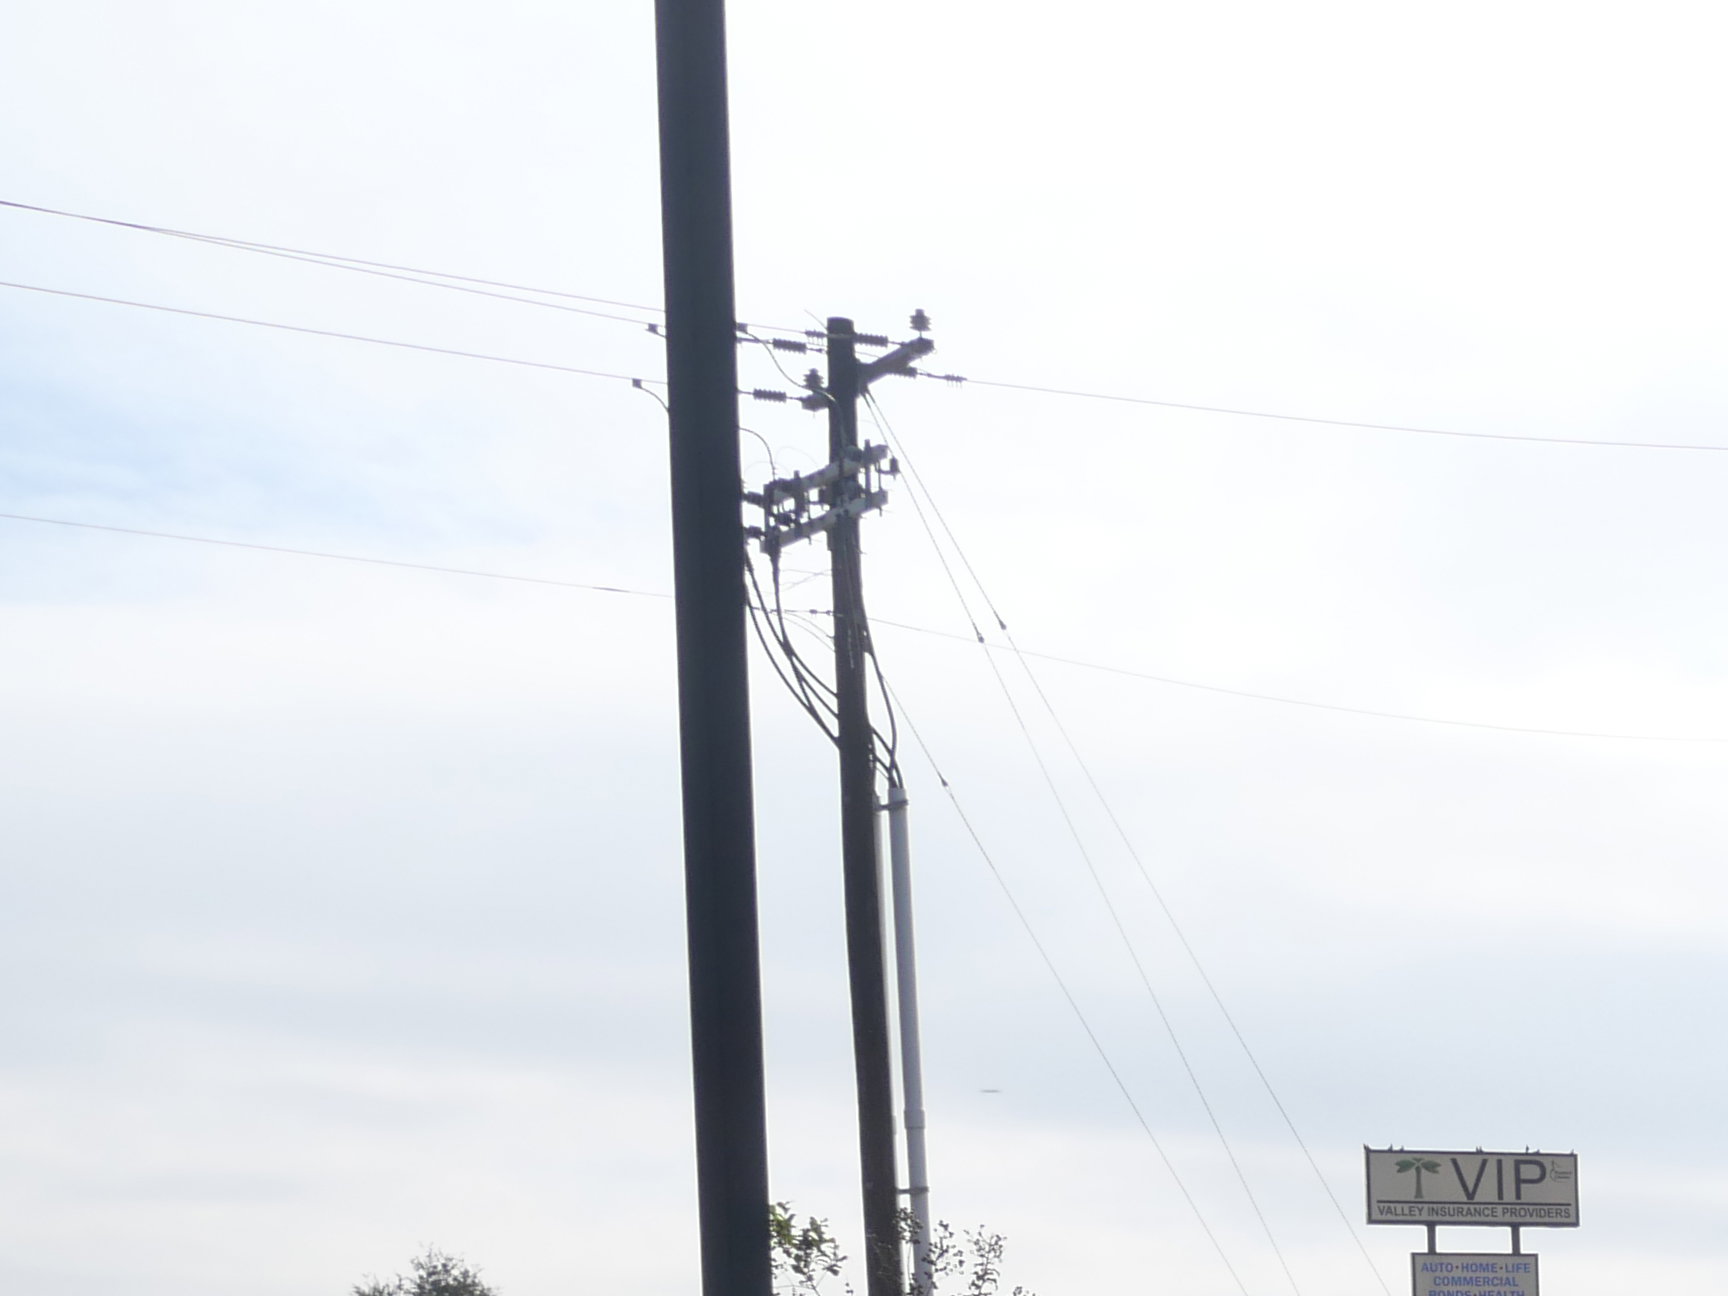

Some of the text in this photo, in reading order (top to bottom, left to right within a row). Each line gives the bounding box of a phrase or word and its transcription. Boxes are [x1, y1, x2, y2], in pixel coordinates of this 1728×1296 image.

[1450, 1158, 1546, 1200] VIP
[1377, 1206, 1571, 1219] VALLEY INSURANCE PROVIDERS
[1421, 1262, 1532, 1273] AUTO HOME LIFE
[1434, 1276, 1519, 1287] COMMERCIAL
